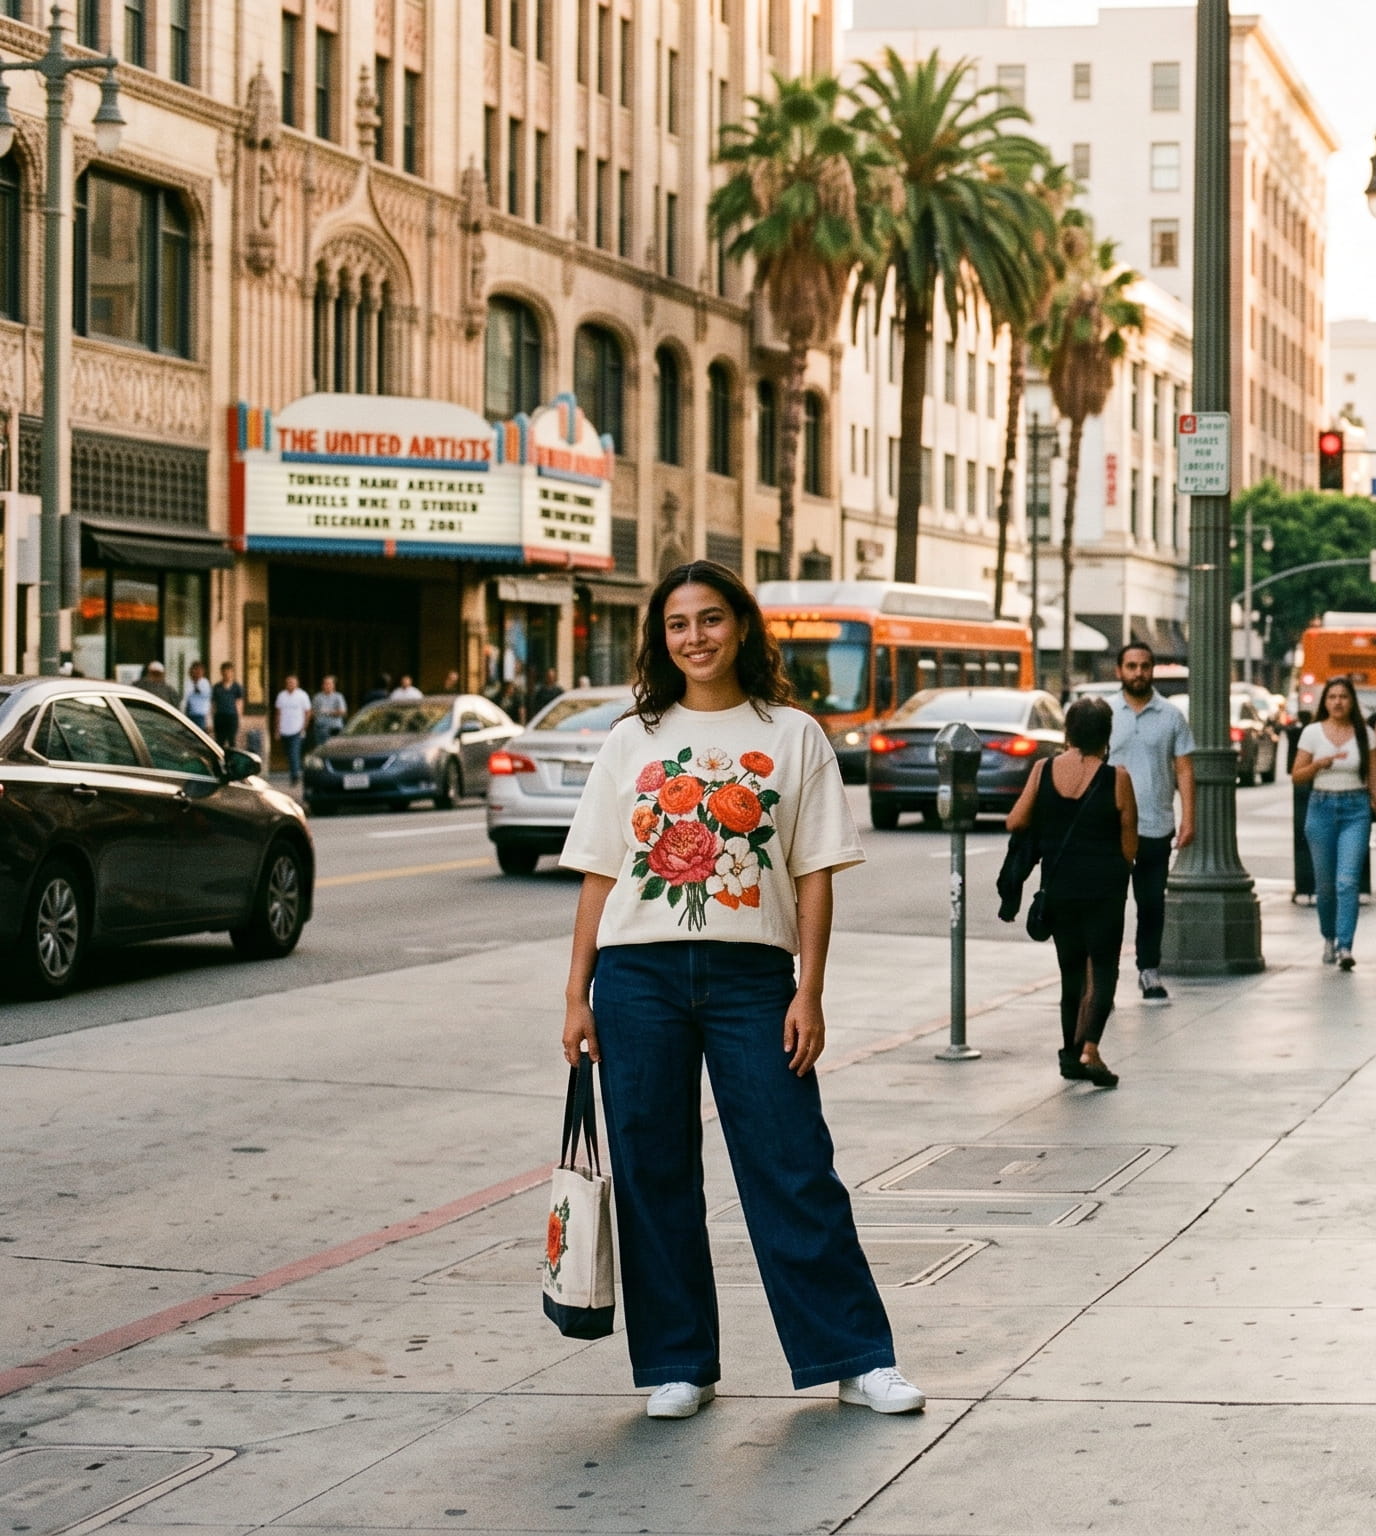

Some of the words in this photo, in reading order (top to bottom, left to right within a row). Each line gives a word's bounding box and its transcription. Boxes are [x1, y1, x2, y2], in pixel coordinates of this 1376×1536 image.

[277, 428, 318, 453] THE
[325, 430, 402, 456] UNITED
[407, 435, 493, 462] ARTISTS
